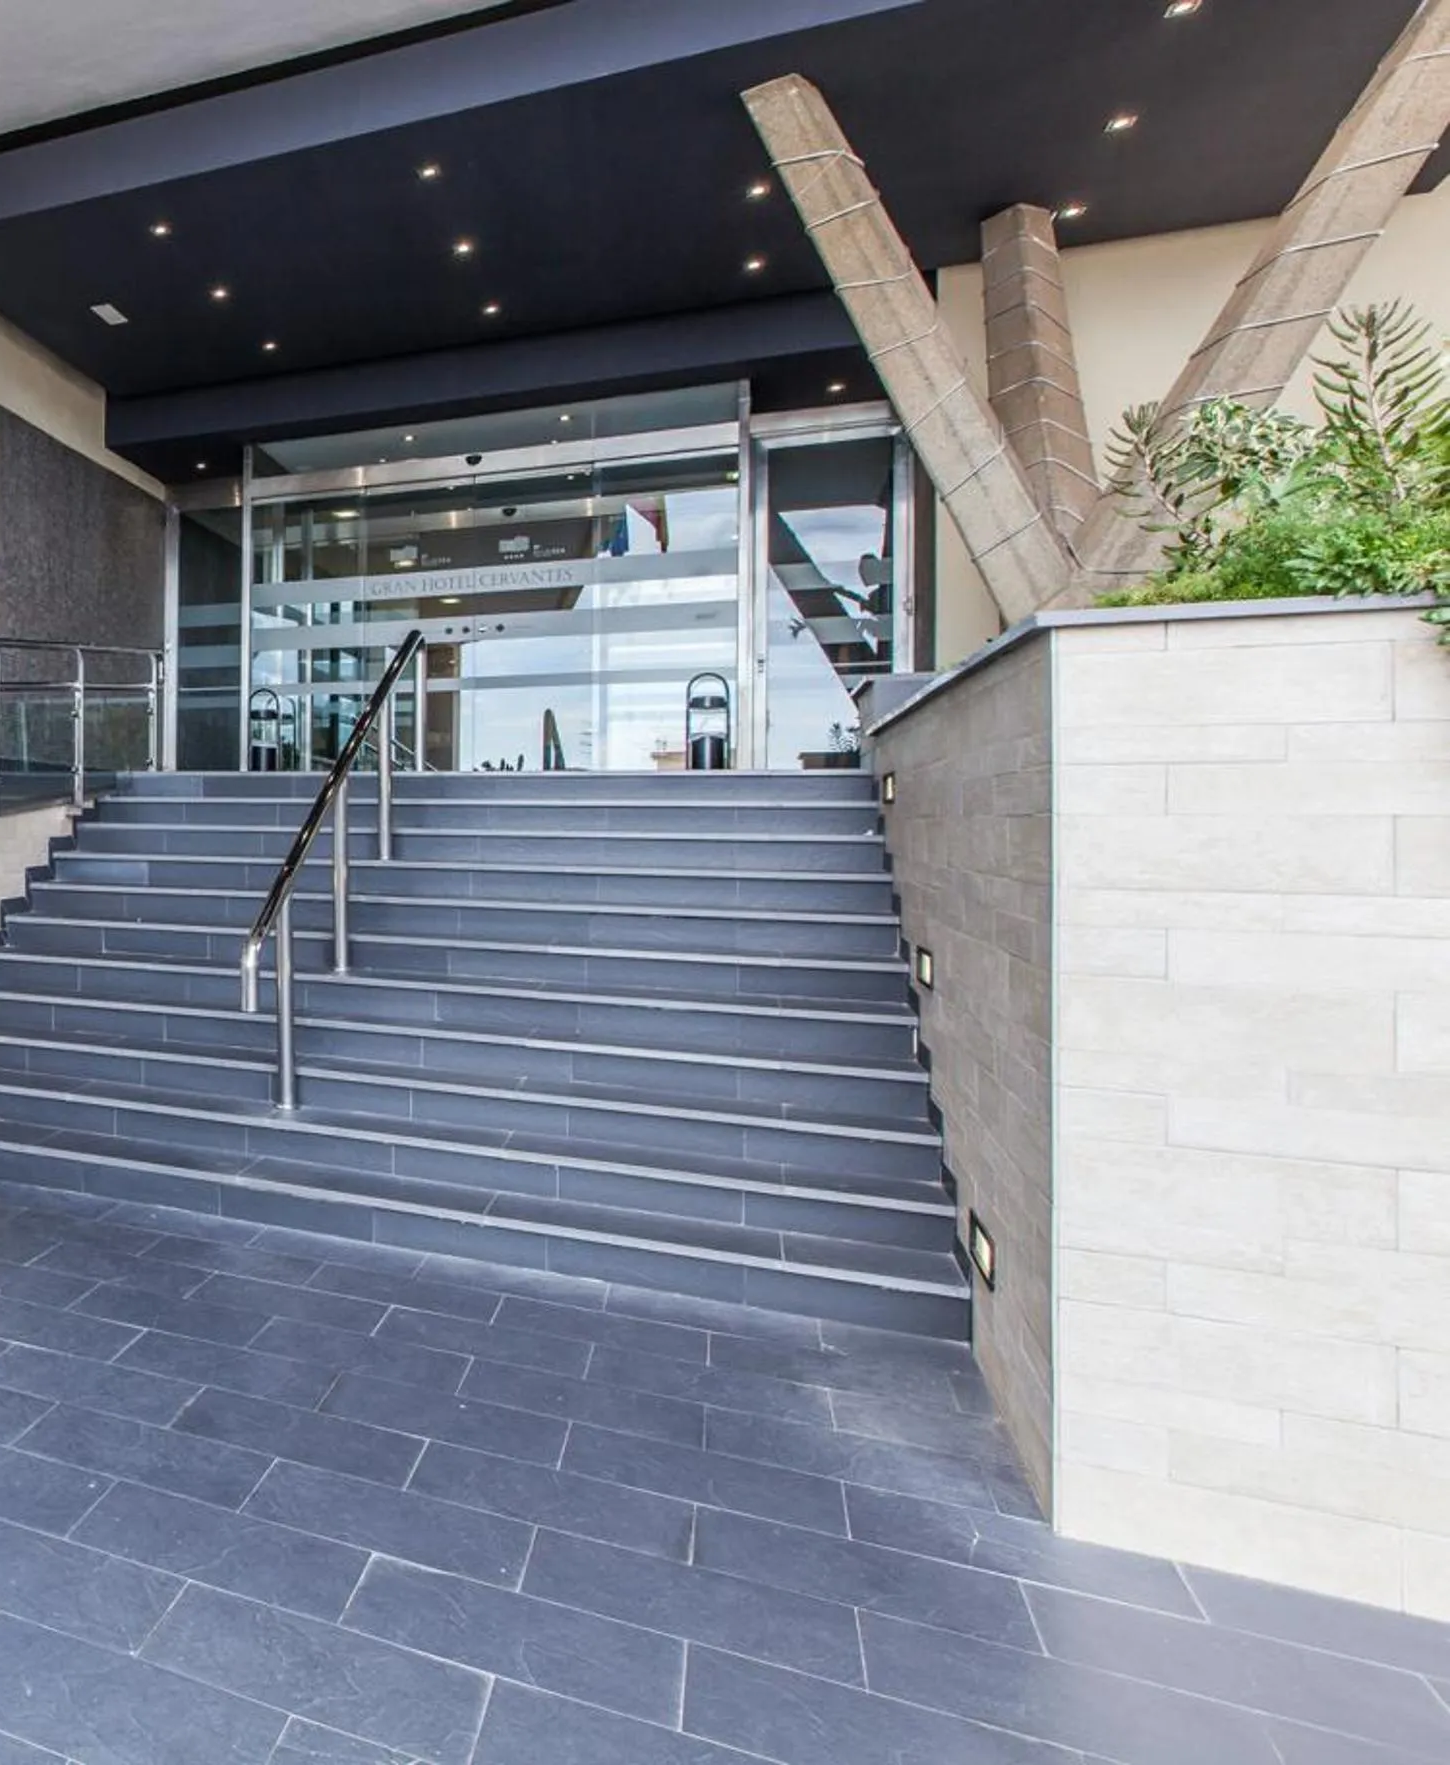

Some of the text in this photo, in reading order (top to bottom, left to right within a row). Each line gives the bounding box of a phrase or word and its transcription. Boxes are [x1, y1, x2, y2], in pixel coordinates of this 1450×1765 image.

[371, 567, 573, 597] GRAN HOTEL CERVANTES
